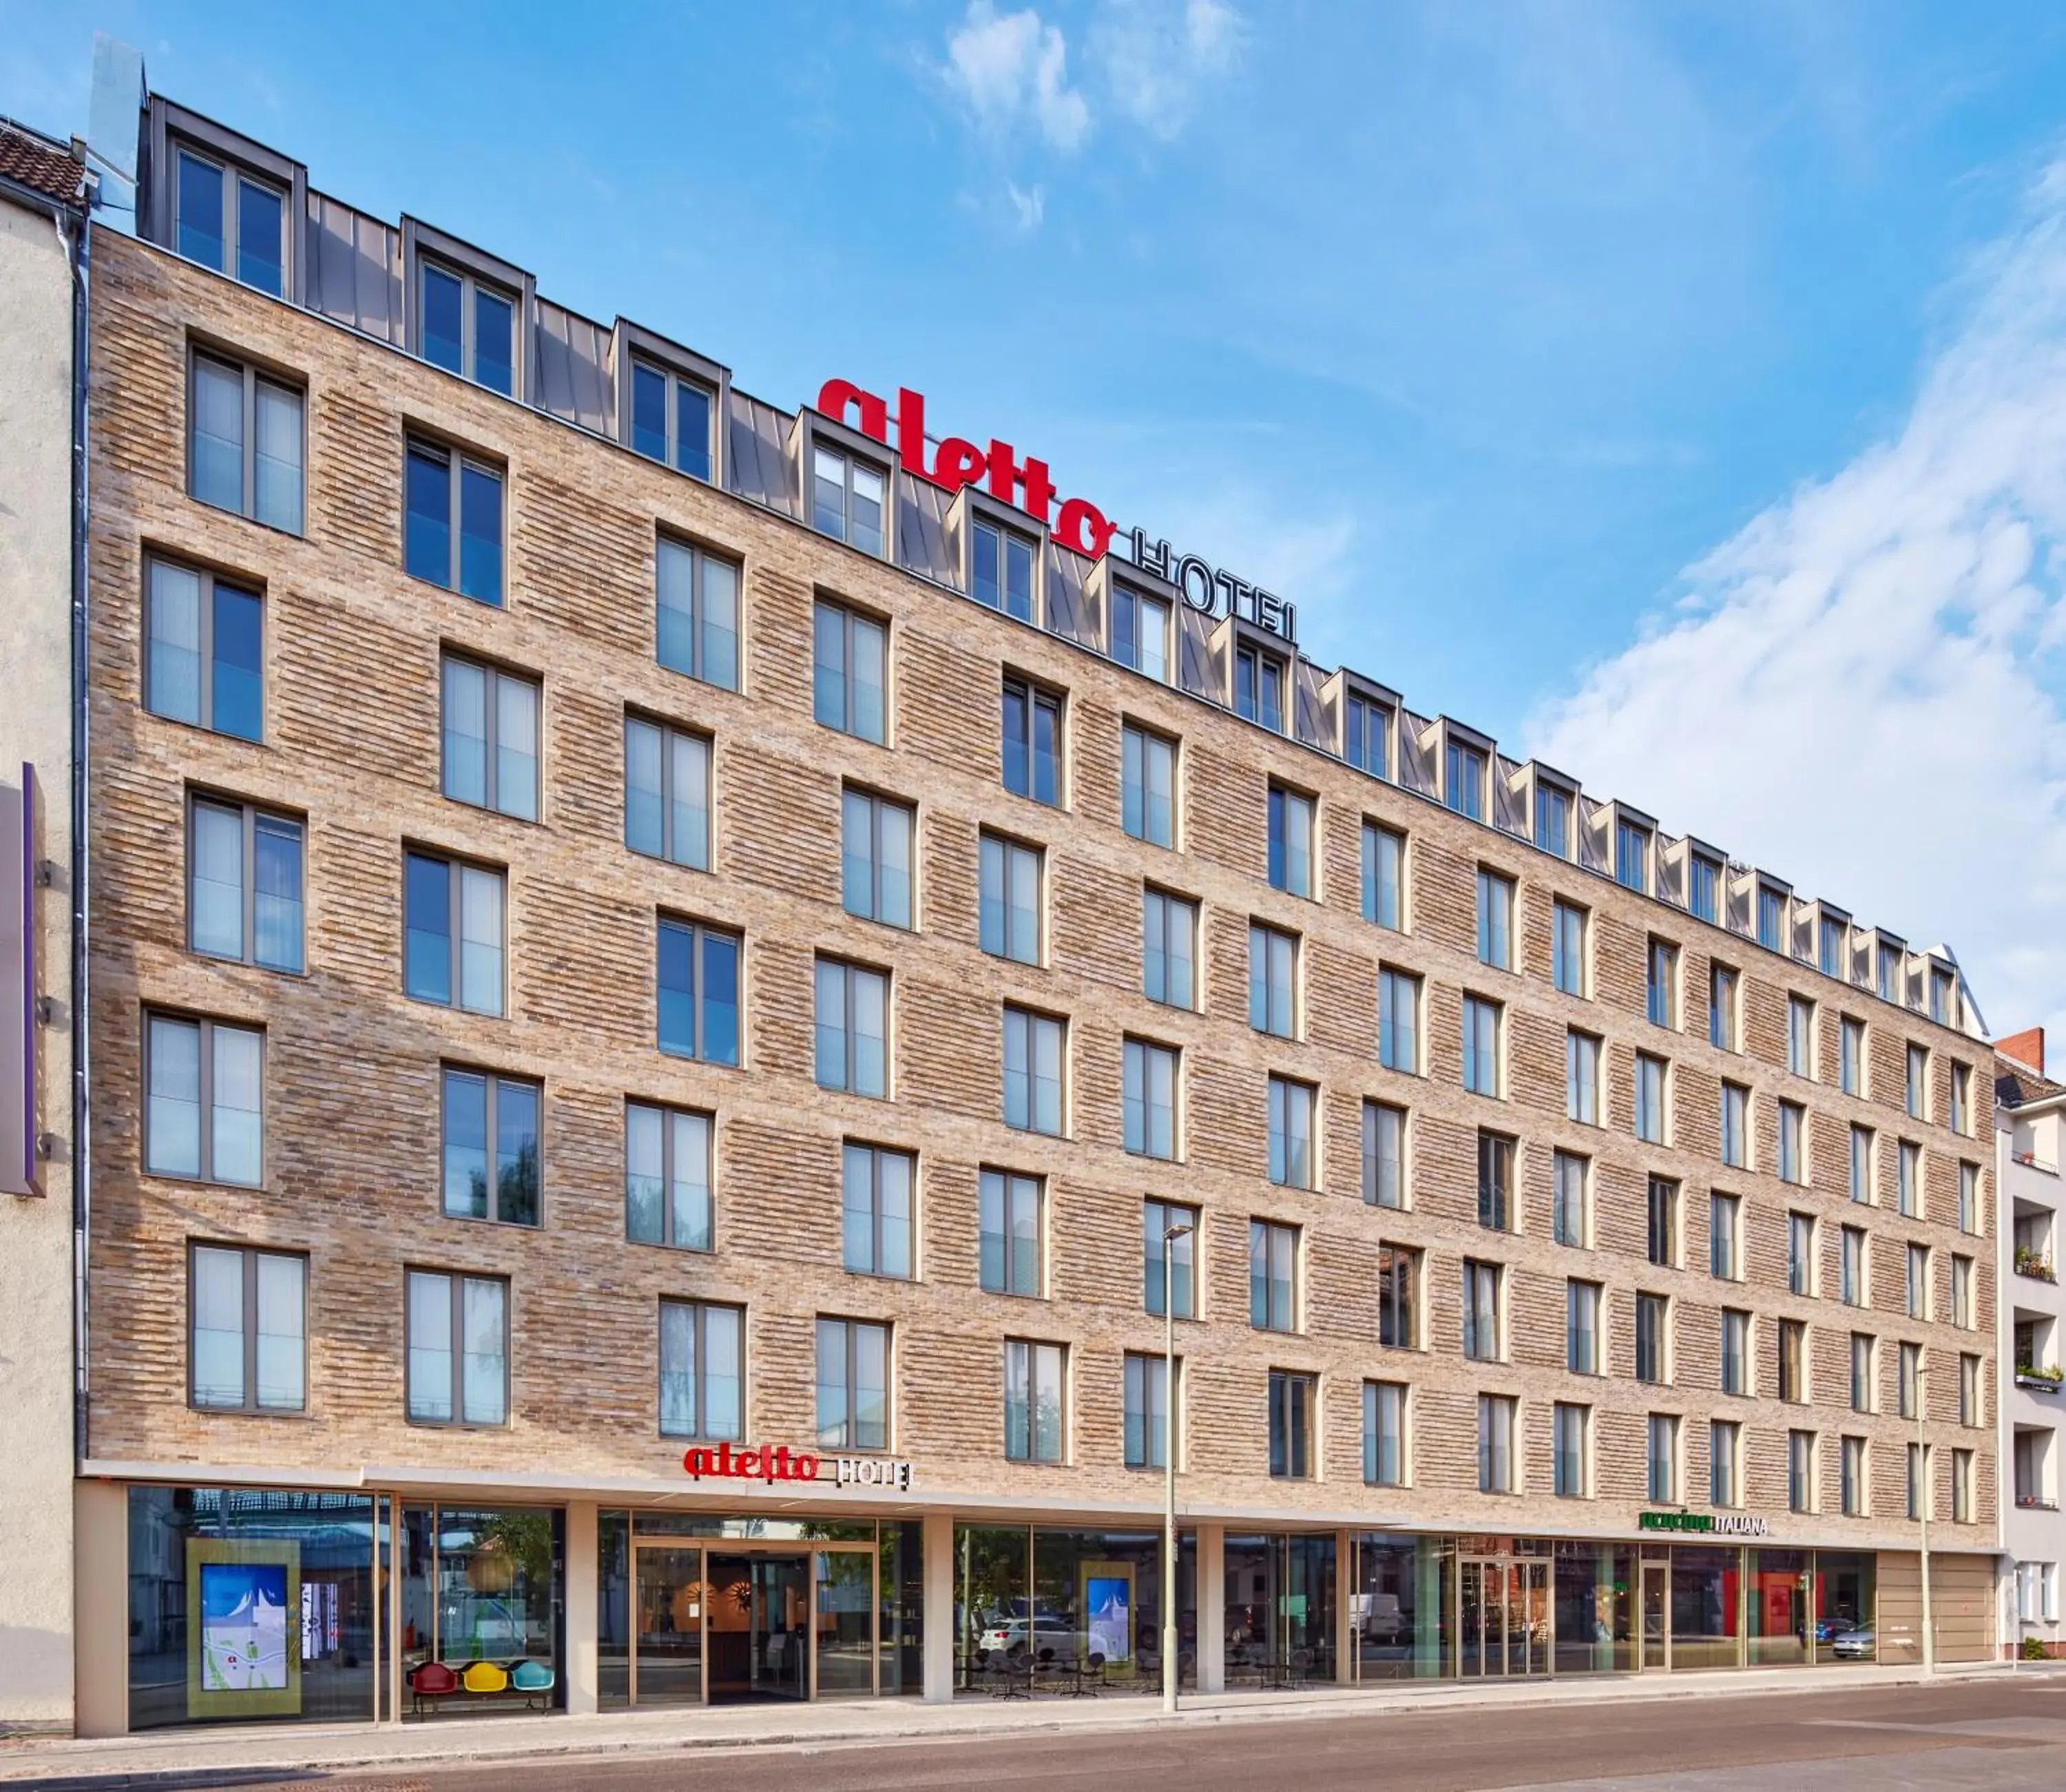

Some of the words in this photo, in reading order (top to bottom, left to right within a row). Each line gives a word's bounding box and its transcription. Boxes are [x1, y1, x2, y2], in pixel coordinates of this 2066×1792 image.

[817, 378, 1118, 561] aletto
[683, 1442, 820, 1480] aletto
[837, 1457, 920, 1487] HOTEL
[1715, 1515, 1768, 1534] ITALIANA
